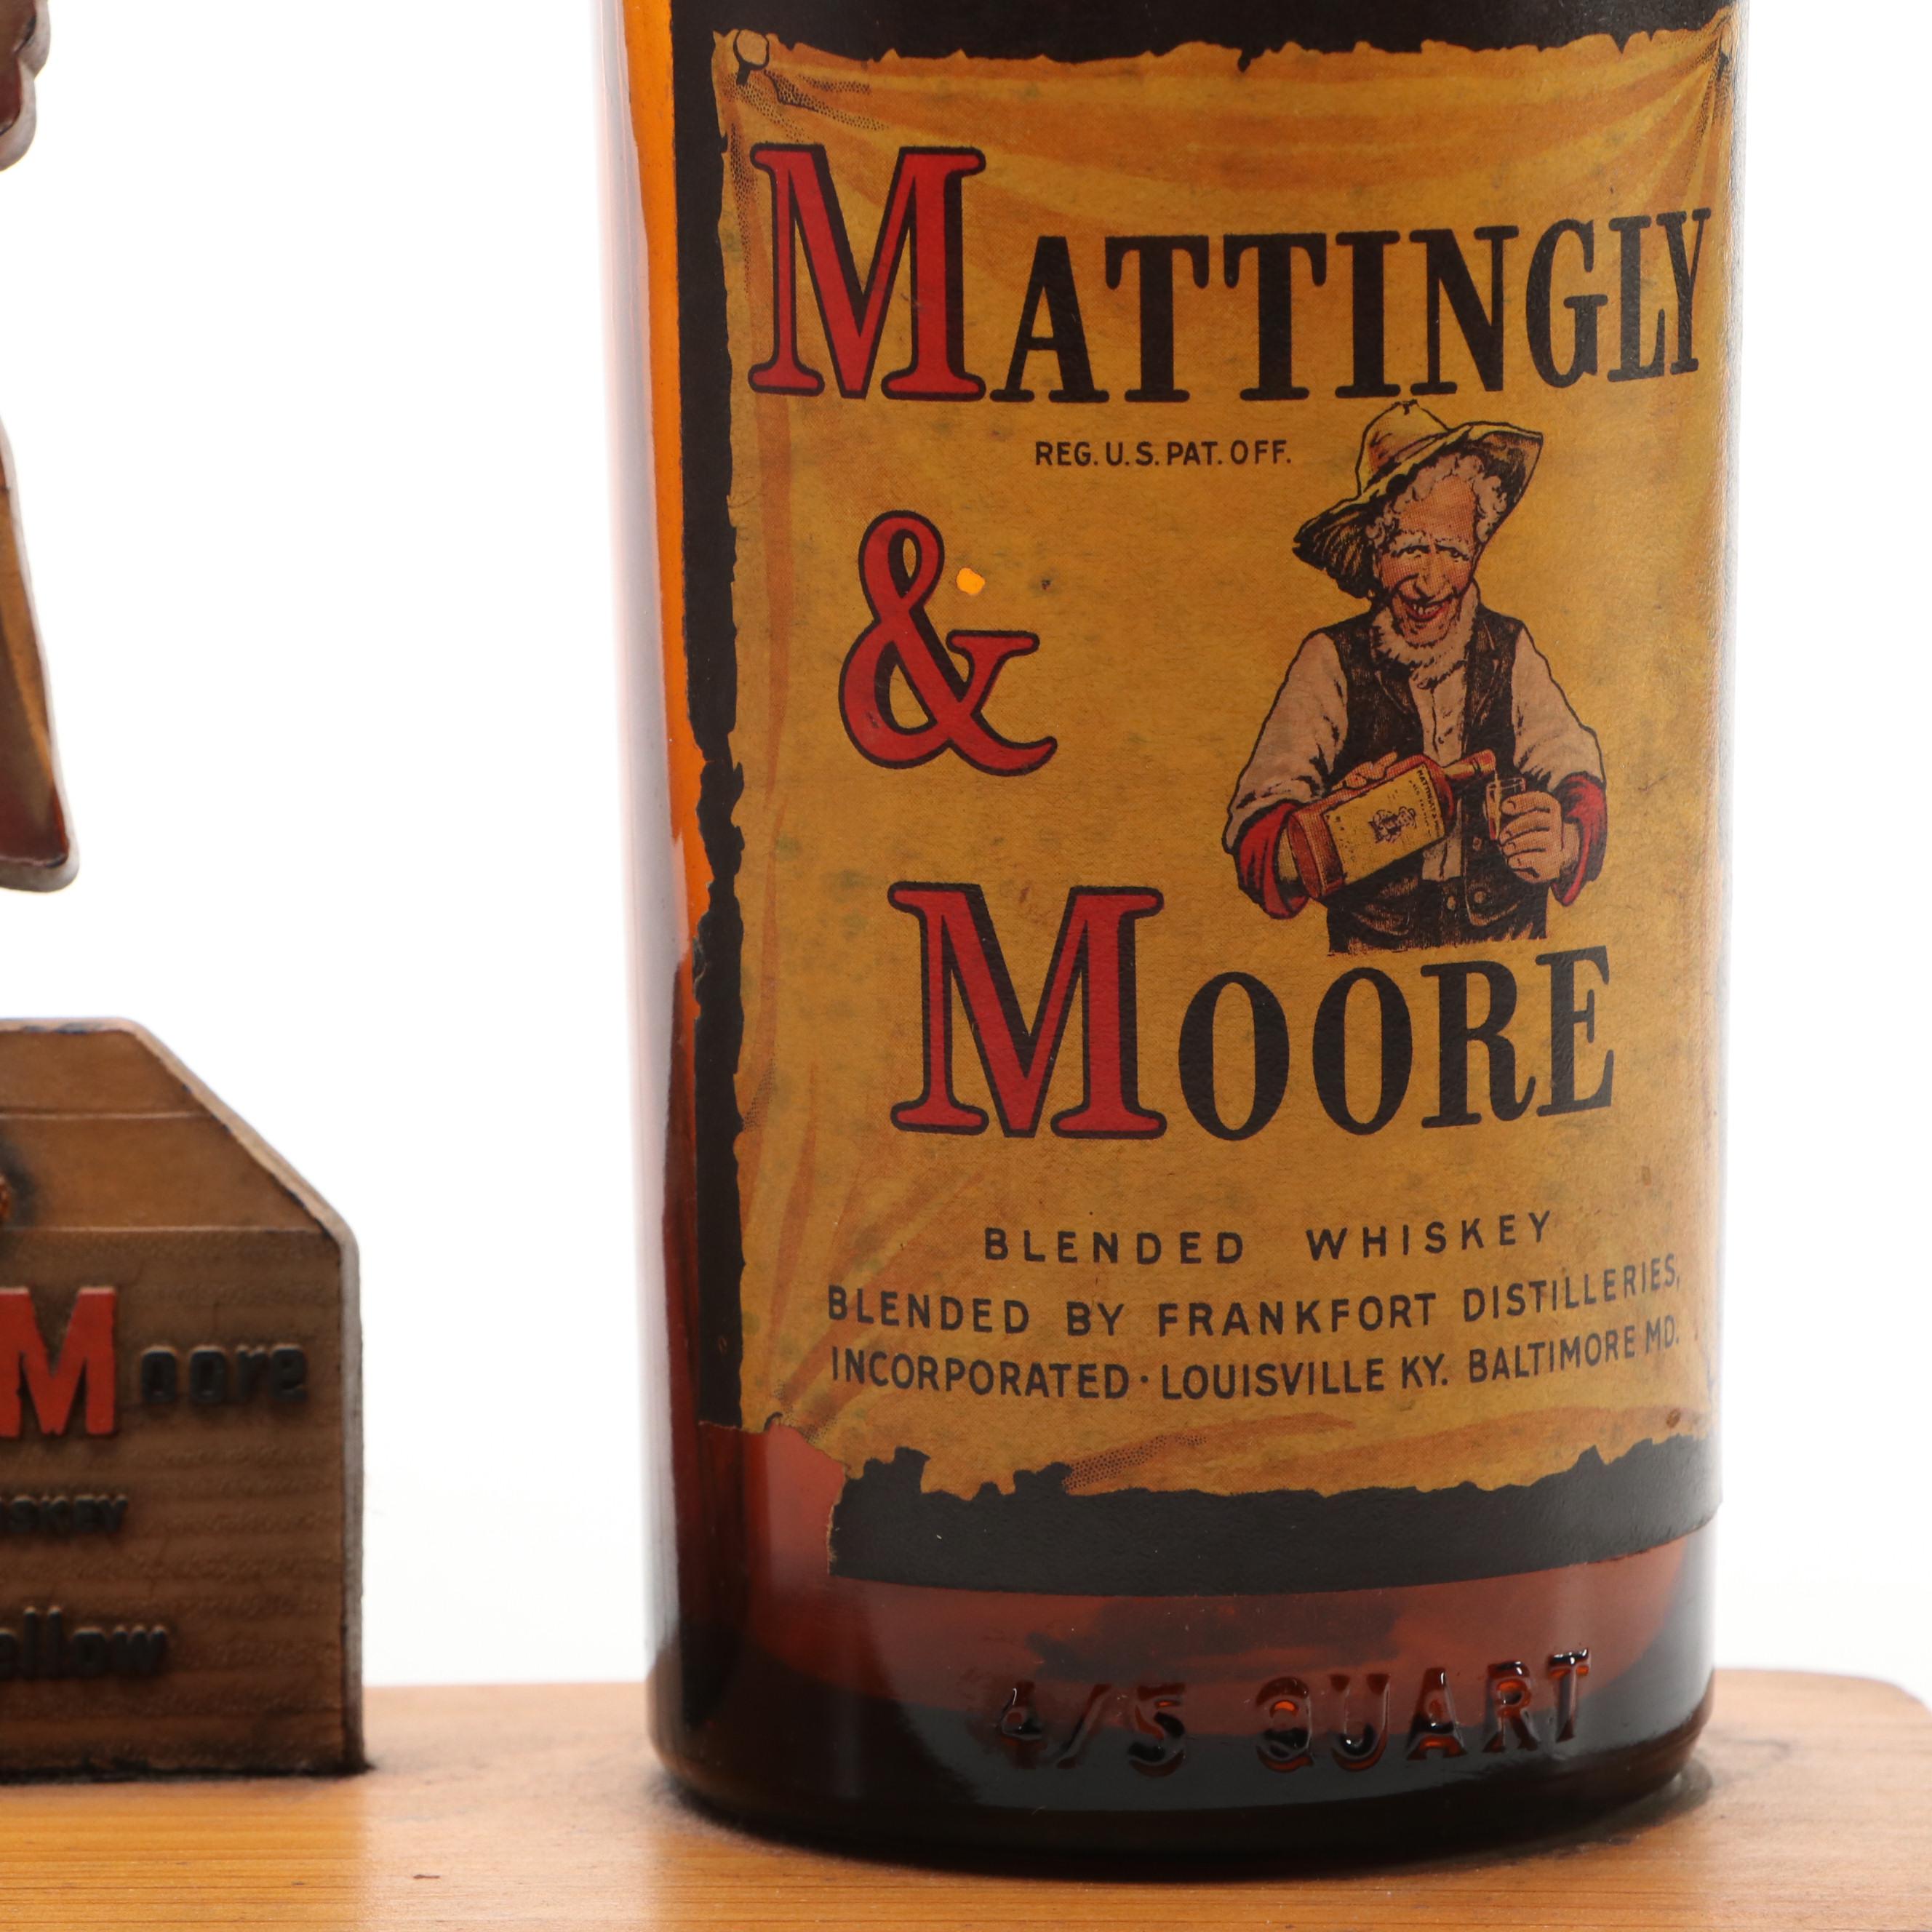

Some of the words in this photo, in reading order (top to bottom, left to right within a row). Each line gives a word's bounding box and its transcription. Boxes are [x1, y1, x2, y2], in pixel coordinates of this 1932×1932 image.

[749, 143, 1712, 403] MATTINGLY
[1035, 441, 1098, 466] REG.
[1105, 441, 1160, 466] U.S.
[1167, 441, 1223, 466] PAT.
[1229, 439, 1291, 465] OFF.
[838, 510, 1058, 776] &
[888, 882, 1615, 1141] MOORE
[983, 1227, 1245, 1264] BLENDED
[1306, 1210, 1551, 1261] WHISKEY
[828, 1285, 1030, 1334] BLENDED
[1066, 1301, 1125, 1336] BY
[1158, 1292, 1437, 1337] FRANKFORT
[1464, 1253, 1680, 1322] DISTILLERIES,
[1162, 1357, 1385, 1401] LOUISVILLE
[1401, 1353, 1449, 1389] KY.
[1468, 1325, 1636, 1383] BALTIMORE
[994, 1680, 1187, 1778] 4/5
[1255, 1647, 1592, 1772] QUART
